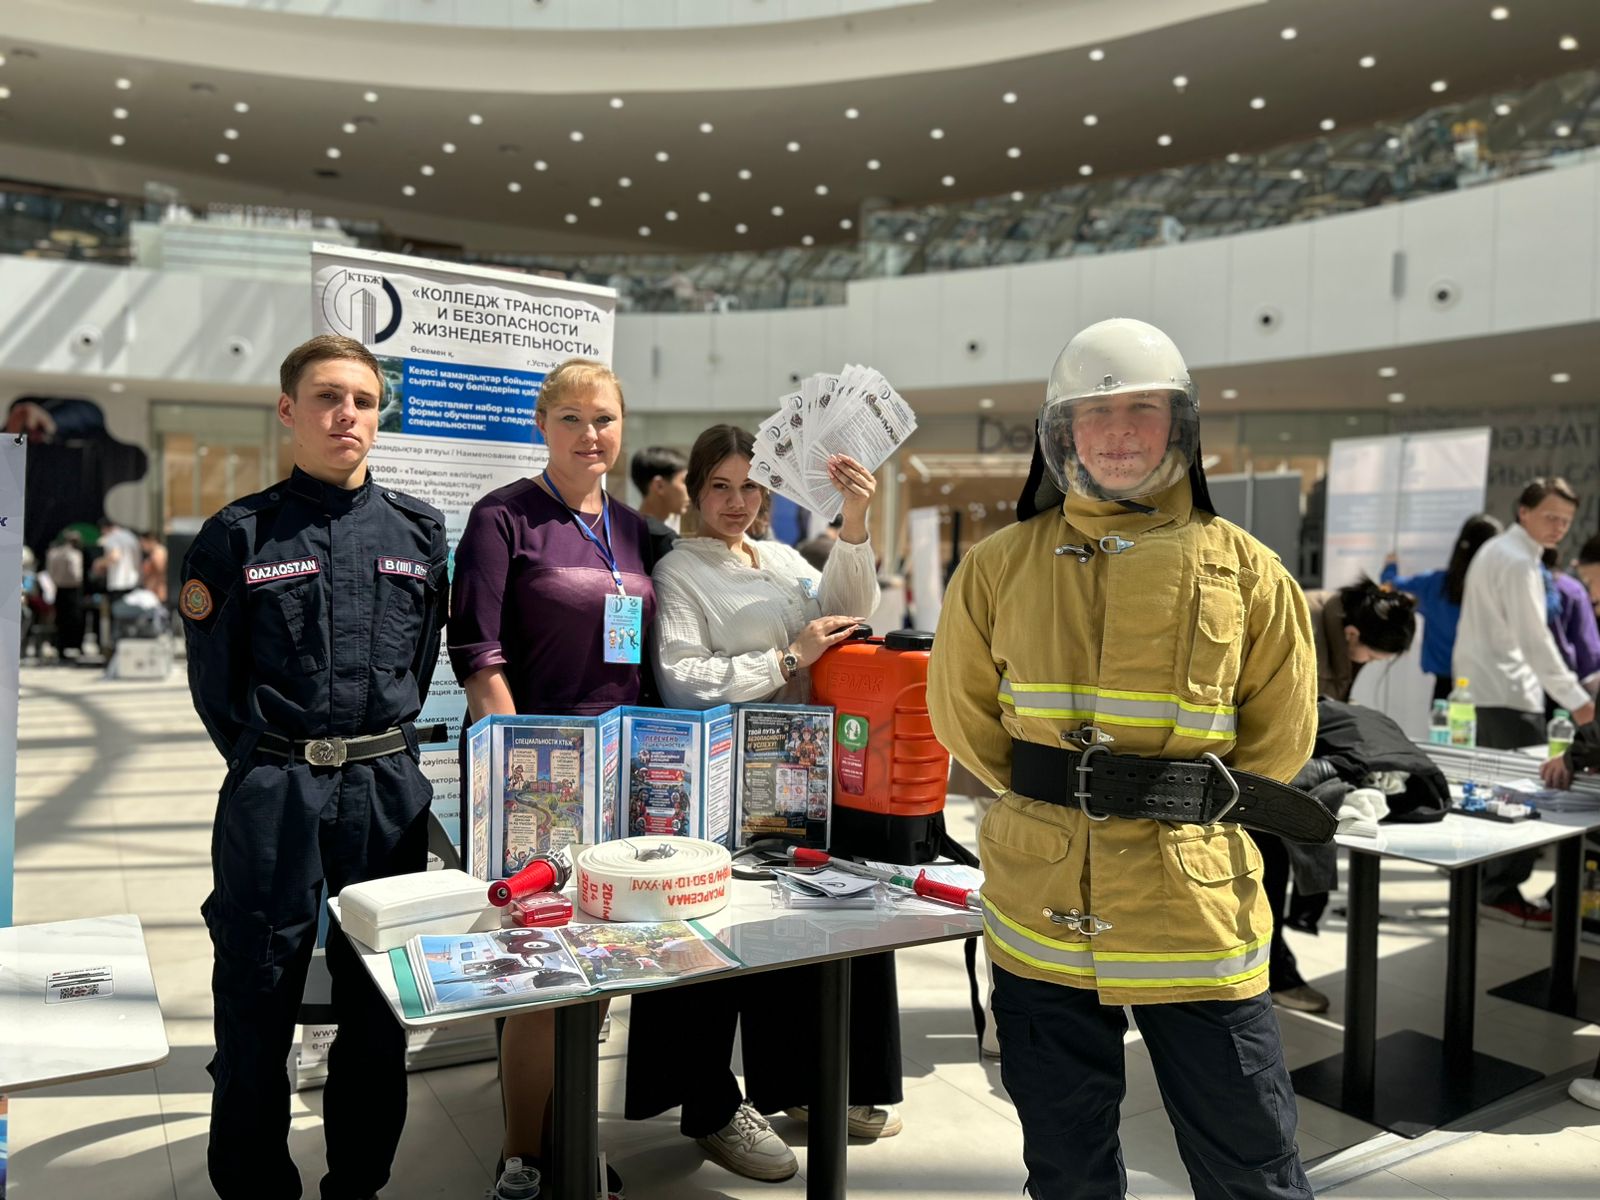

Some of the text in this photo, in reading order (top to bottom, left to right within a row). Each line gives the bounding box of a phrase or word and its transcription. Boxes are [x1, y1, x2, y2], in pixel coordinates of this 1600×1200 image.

[347, 272, 382, 285] КТБЖ
[411, 286, 600, 323] «КОЛЛЕДЖ ТРАНСПОРТА
[437, 307, 579, 337] И БЕЗОПАСНОСТИ
[412, 321, 600, 356] ЖИЗНЕДЕЯТЕЛЬНОСТИ»
[410, 345, 446, 356] Өскемен
[408, 366, 438, 377] Келесі
[439, 370, 501, 384] мамандықтар
[408, 377, 447, 388] сырттай
[448, 381, 464, 391] оқу
[408, 396, 474, 410] Осуществляет
[475, 404, 503, 414] набор
[408, 406, 442, 417] формы
[443, 409, 487, 421] обучения
[408, 418, 487, 431] специальностям:
[248, 560, 317, 580] QAZAQSTAN
